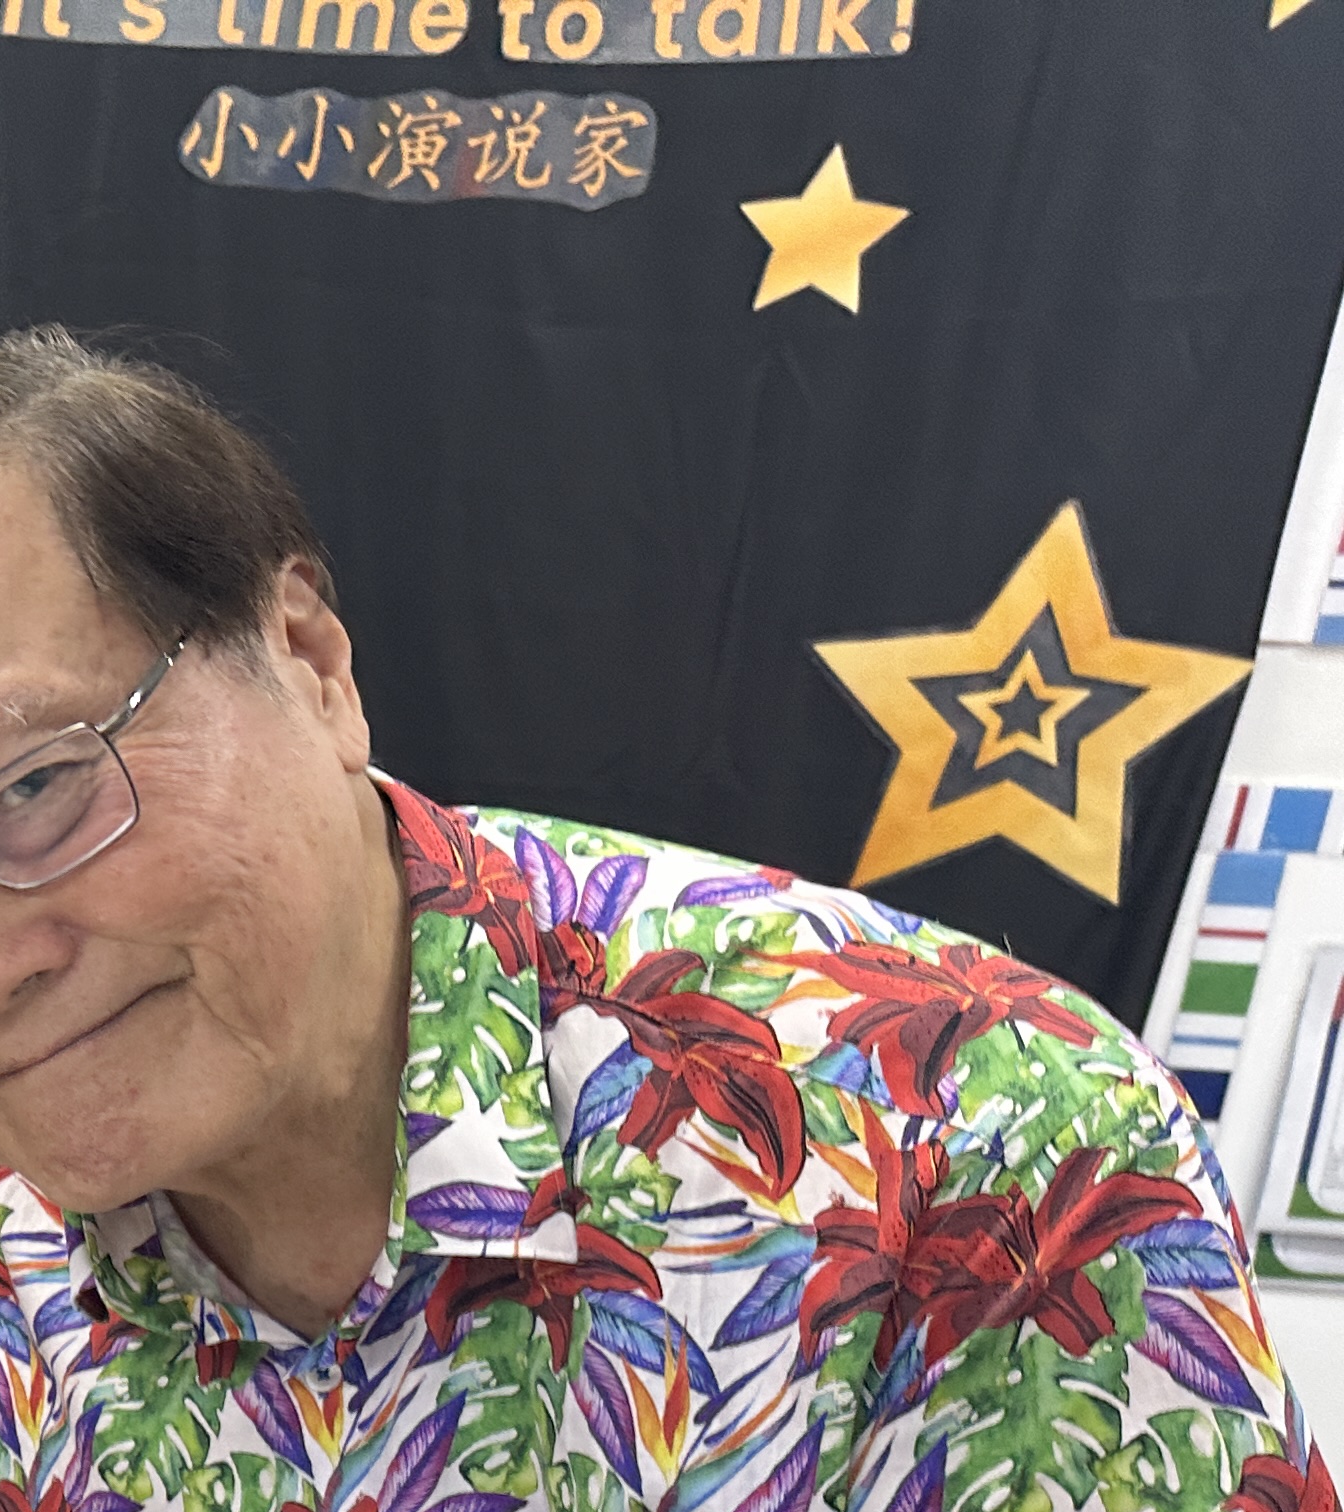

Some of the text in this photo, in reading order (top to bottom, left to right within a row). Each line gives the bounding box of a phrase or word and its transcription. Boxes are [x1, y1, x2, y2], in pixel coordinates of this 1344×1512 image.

[499, 0, 603, 60] to
[183, 92, 651, 197] 小小演说家
